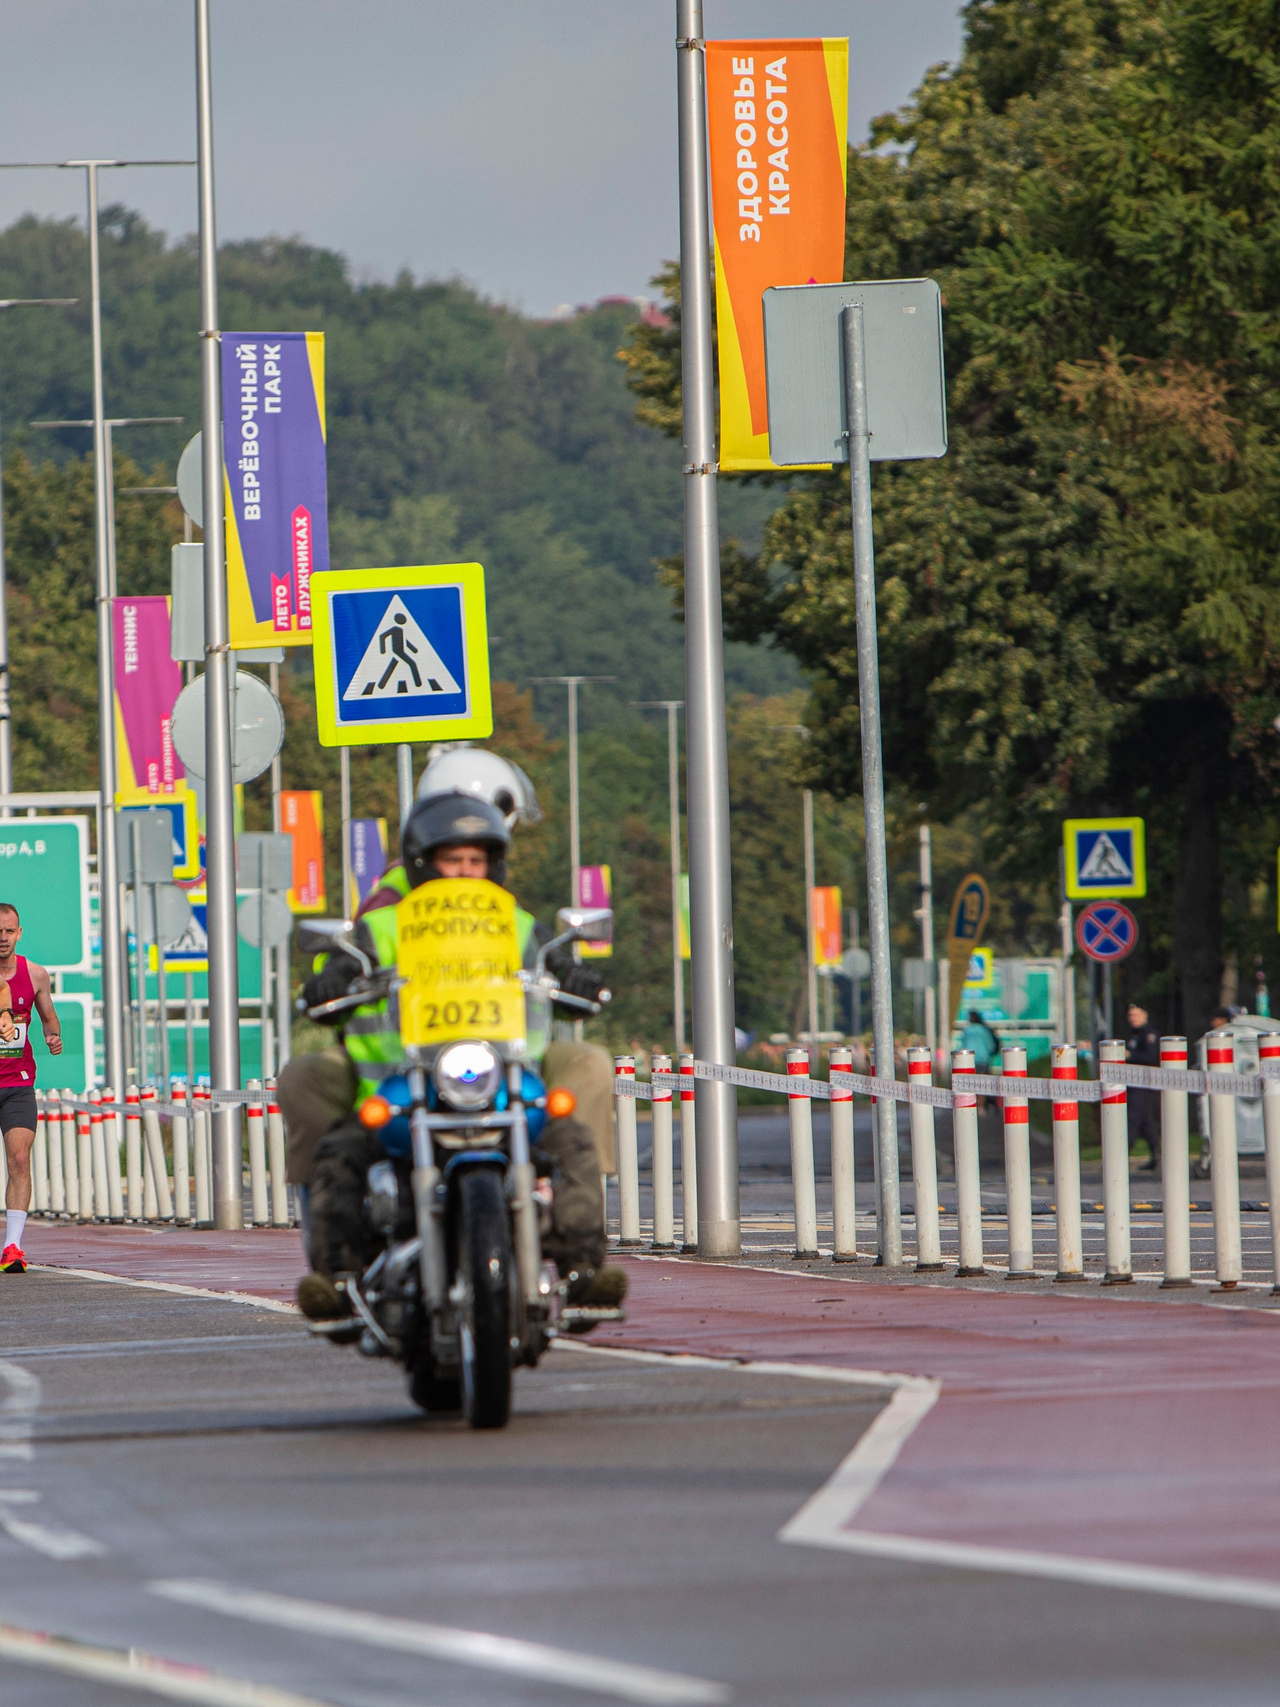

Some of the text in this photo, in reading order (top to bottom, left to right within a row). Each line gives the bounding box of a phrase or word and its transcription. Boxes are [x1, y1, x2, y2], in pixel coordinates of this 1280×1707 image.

[732, 56, 763, 243] ЗДОРОВЬЕ
[765, 56, 791, 215] КРАСОТА
[264, 343, 281, 413] ПАРК
[236, 343, 261, 521] ВЕРЁВОЧНЫЙ
[275, 584, 289, 628] ЛЕТО
[295, 516, 311, 626] В ЛУЖНИКАХ
[123, 605, 138, 675] ТЕННИС
[401, 917, 513, 942] ПРОПУСК
[410, 893, 502, 918] ТРАССА
[423, 1000, 502, 1028] 2023
